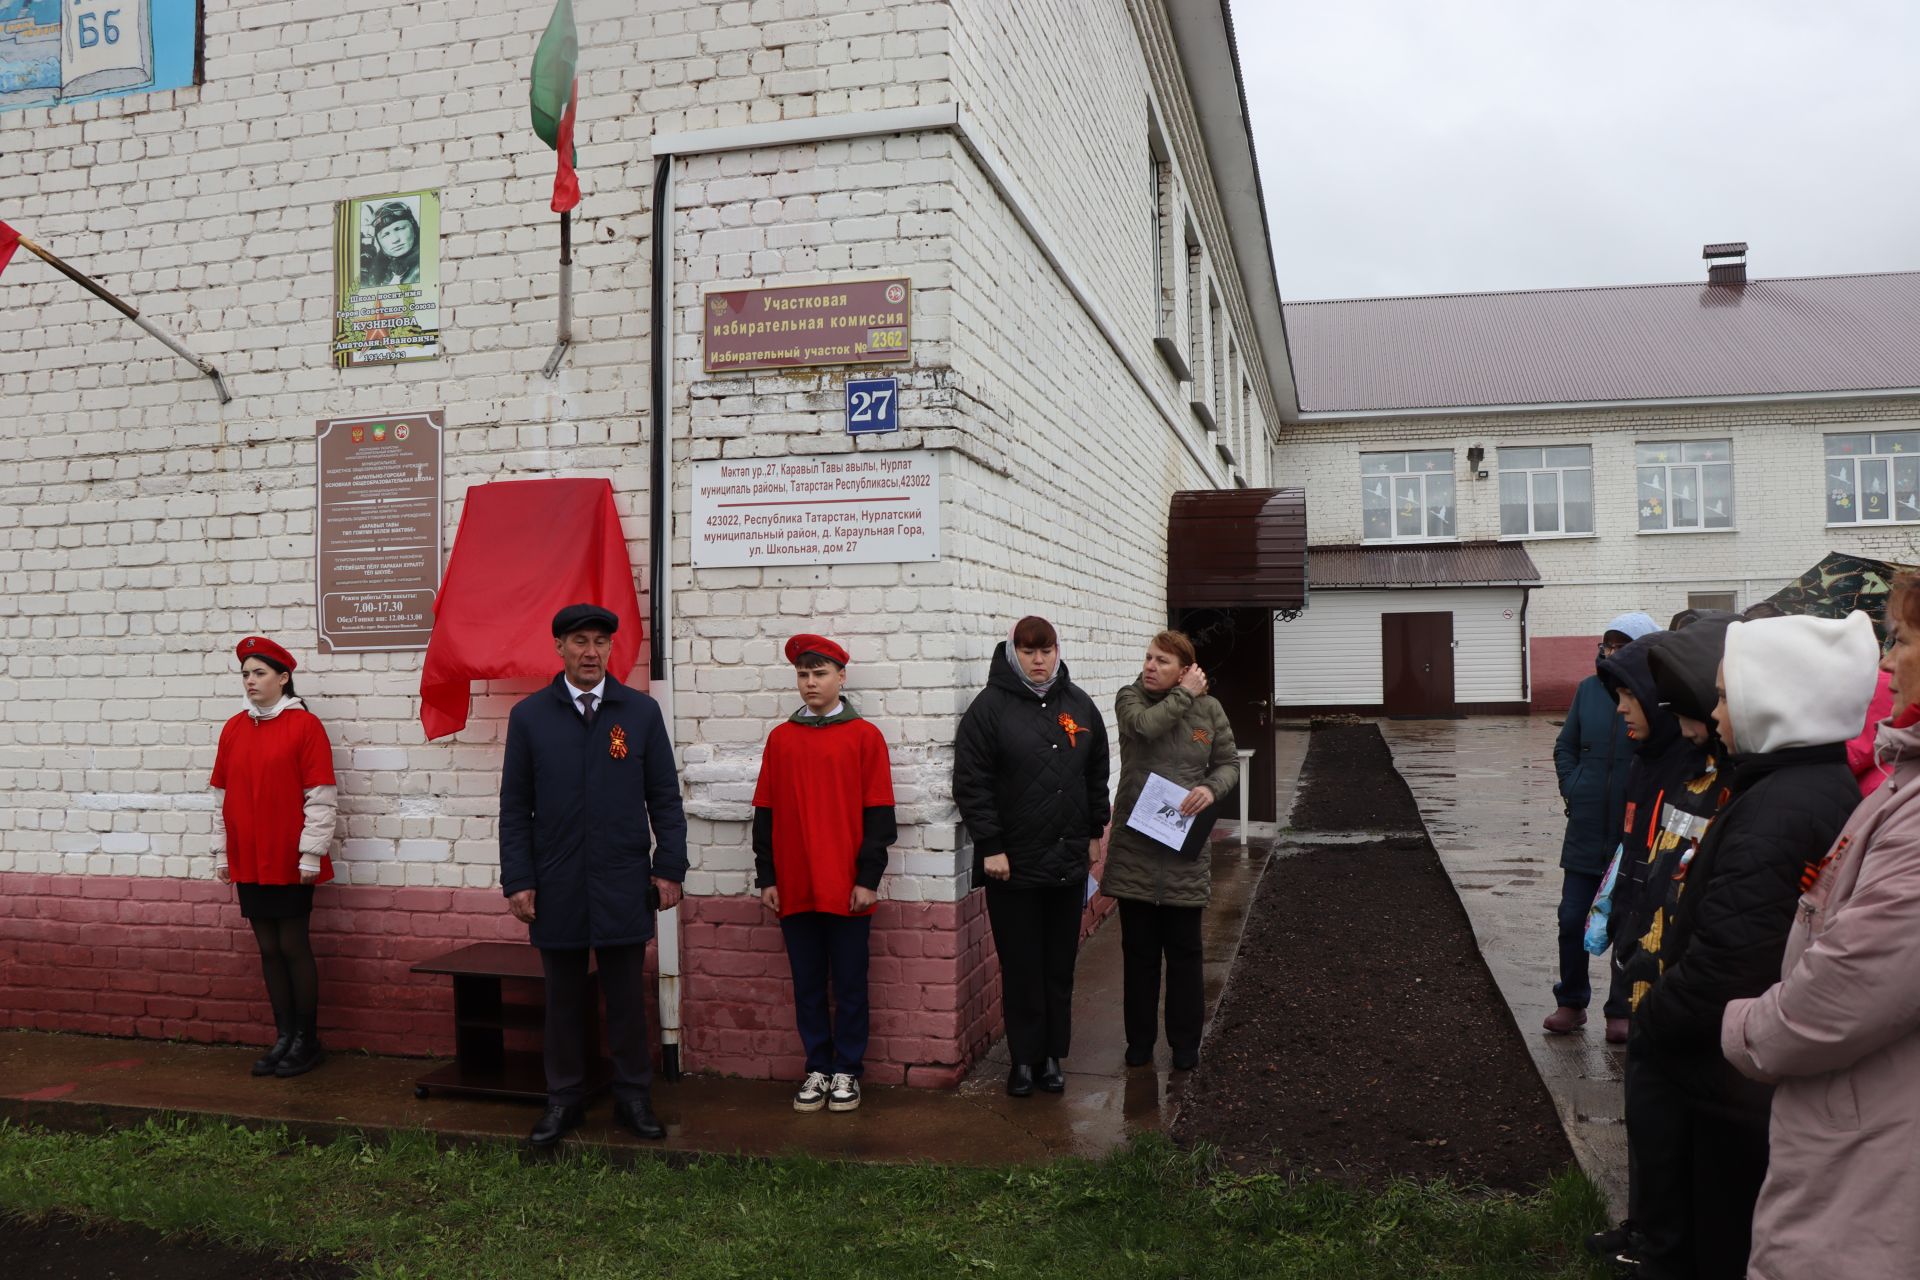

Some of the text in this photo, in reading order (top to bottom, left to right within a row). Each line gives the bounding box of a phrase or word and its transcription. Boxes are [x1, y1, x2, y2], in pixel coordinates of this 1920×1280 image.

[350, 295, 375, 303] Школа
[763, 292, 847, 311] Участковая
[336, 303, 436, 318] Героя Советского Союза
[353, 317, 417, 331] КУЗНЕЦОВА
[713, 312, 904, 337] избирательная комиссия
[383, 335, 435, 346] Ивановича
[711, 330, 902, 363] Избирательный участок № 2362
[851, 390, 892, 422] 27
[720, 465, 750, 478] Мәктәп
[781, 462, 819, 475] Каравыл
[821, 461, 844, 473] Тавы
[845, 461, 878, 473] авылы,
[881, 459, 912, 473] Нурлат
[700, 483, 751, 497] муниципаль
[753, 482, 788, 496] районы,
[791, 479, 833, 493] Татарстан
[706, 509, 922, 527] 423022, Республика Татарстан, Нурлатский
[704, 525, 925, 542] муниципальный район, д. Караульная Гора,
[749, 542, 857, 557] ул. Школьная, дом 27
[354, 601, 403, 613] 7.00-17.30
